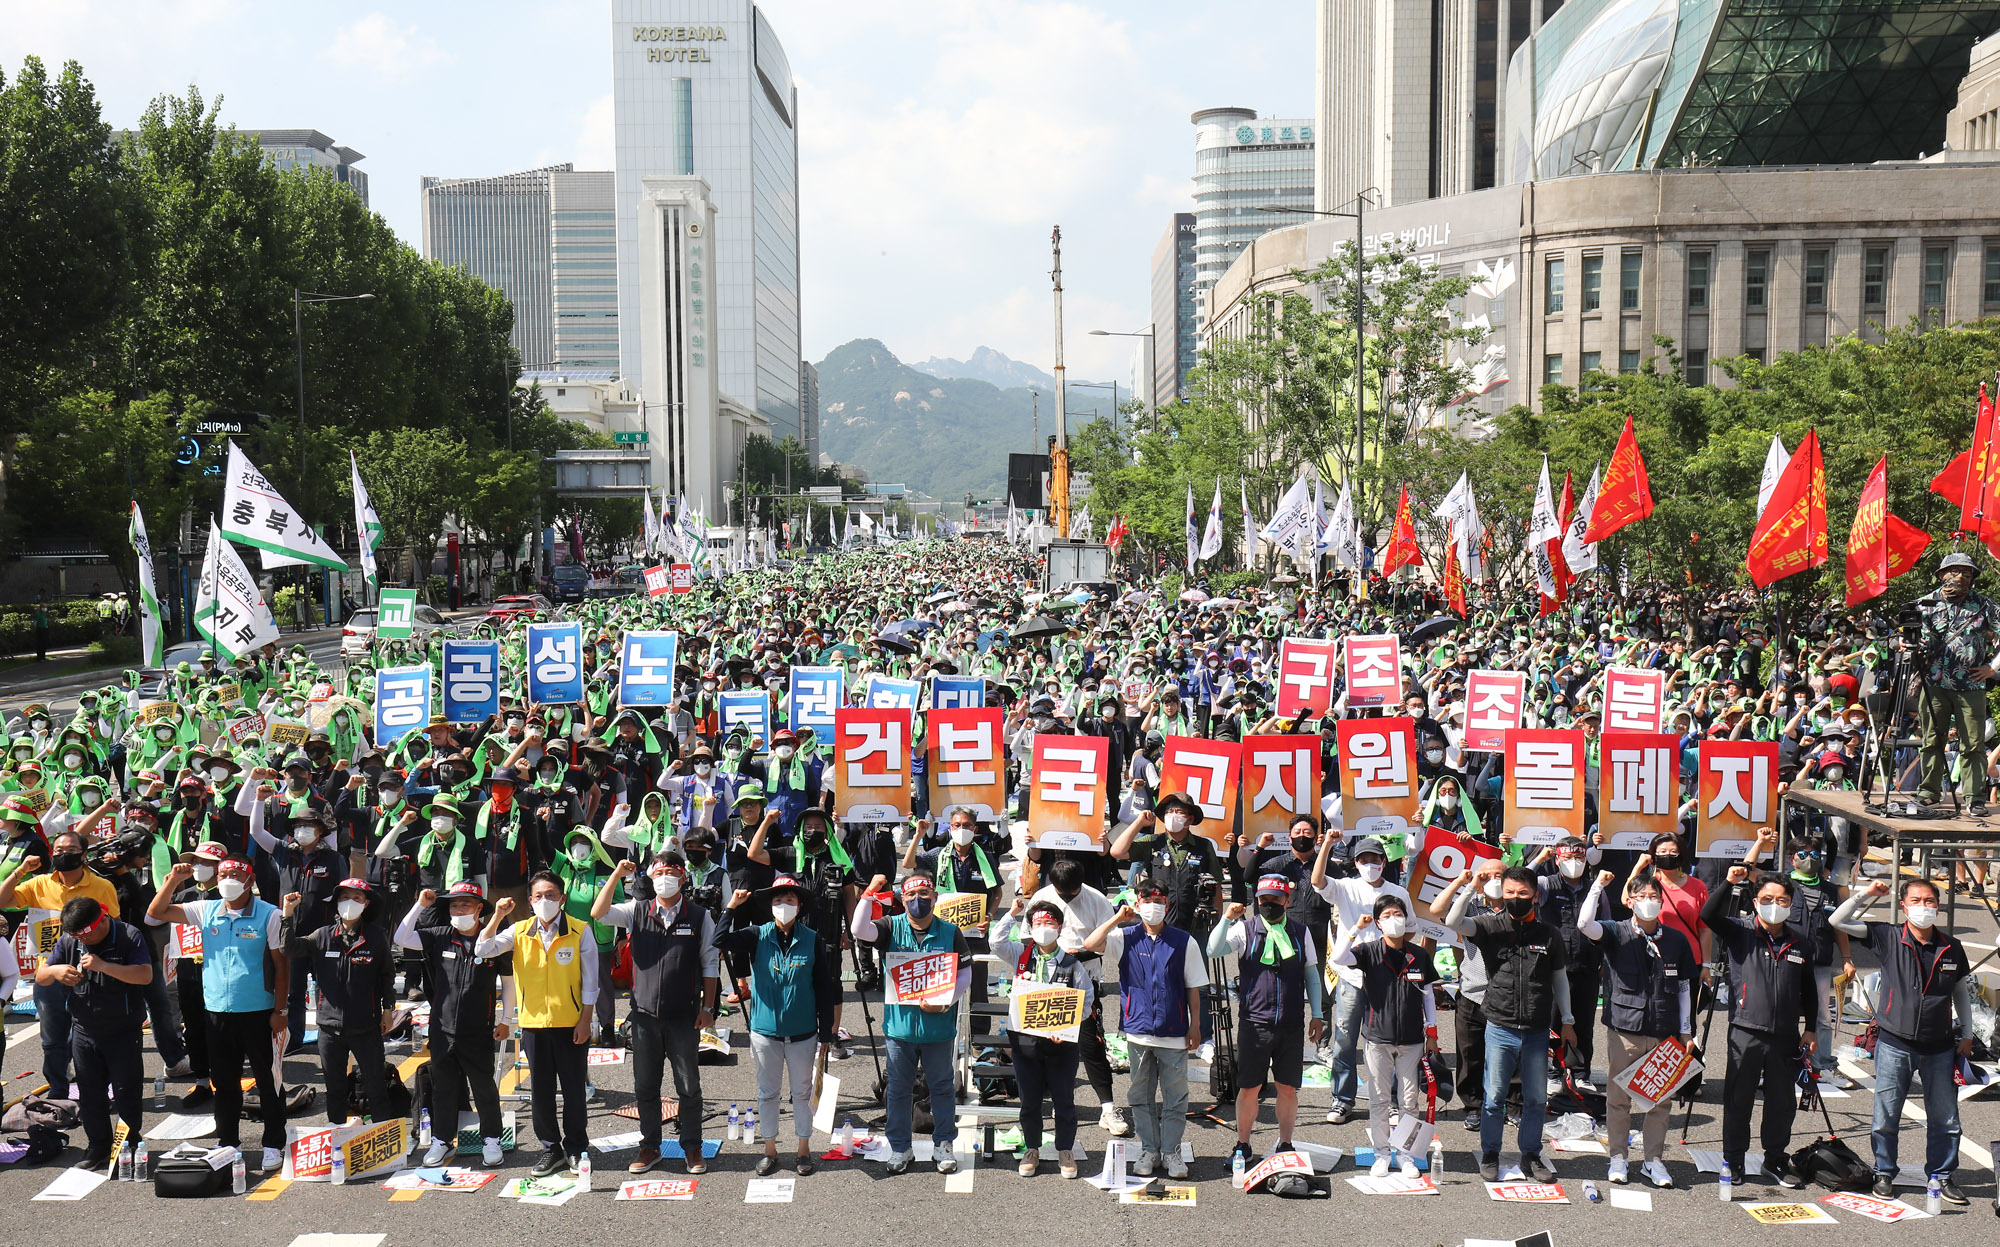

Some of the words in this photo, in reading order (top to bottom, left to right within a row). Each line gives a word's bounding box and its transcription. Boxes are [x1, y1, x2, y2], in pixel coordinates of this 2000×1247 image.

[632, 26, 727, 42] KOREANA
[647, 47, 711, 62] HOTEL
[1400, 222, 1451, 248] 벗어나
[689, 244, 705, 369] 서울특별시의회
[620, 433, 643, 443] 시청
[380, 598, 413, 628] 교
[449, 654, 493, 702] 공
[534, 635, 577, 684] 성
[625, 643, 669, 685] 노
[1283, 651, 1329, 701] 구
[1352, 646, 1396, 688] 조
[232, 714, 264, 733] 노동자는
[381, 678, 425, 727] 공
[1469, 683, 1516, 730] 조
[1609, 680, 1656, 731] 분
[845, 721, 903, 787] 건
[937, 721, 996, 786] 보
[1348, 730, 1410, 799] 원
[1514, 742, 1575, 810] 몰
[1039, 747, 1098, 816] 국
[1174, 750, 1230, 820] 고
[1253, 748, 1312, 815] 지
[1609, 748, 1671, 815] 폐
[1708, 755, 1769, 823] 지
[940, 899, 982, 919] 물가폭등
[944, 911, 981, 928] 살겠다
[898, 955, 953, 981] 노동자는
[898, 968, 953, 995] 죽어난다
[1023, 1010, 1076, 1029] 못살겠다
[1025, 995, 1079, 1015] 물가폭등
[1633, 1040, 1675, 1090] 노동자는
[1643, 1048, 1685, 1098] 죽어난다
[350, 1125, 401, 1161] 물가폭등
[350, 1141, 402, 1176] 못살겠다
